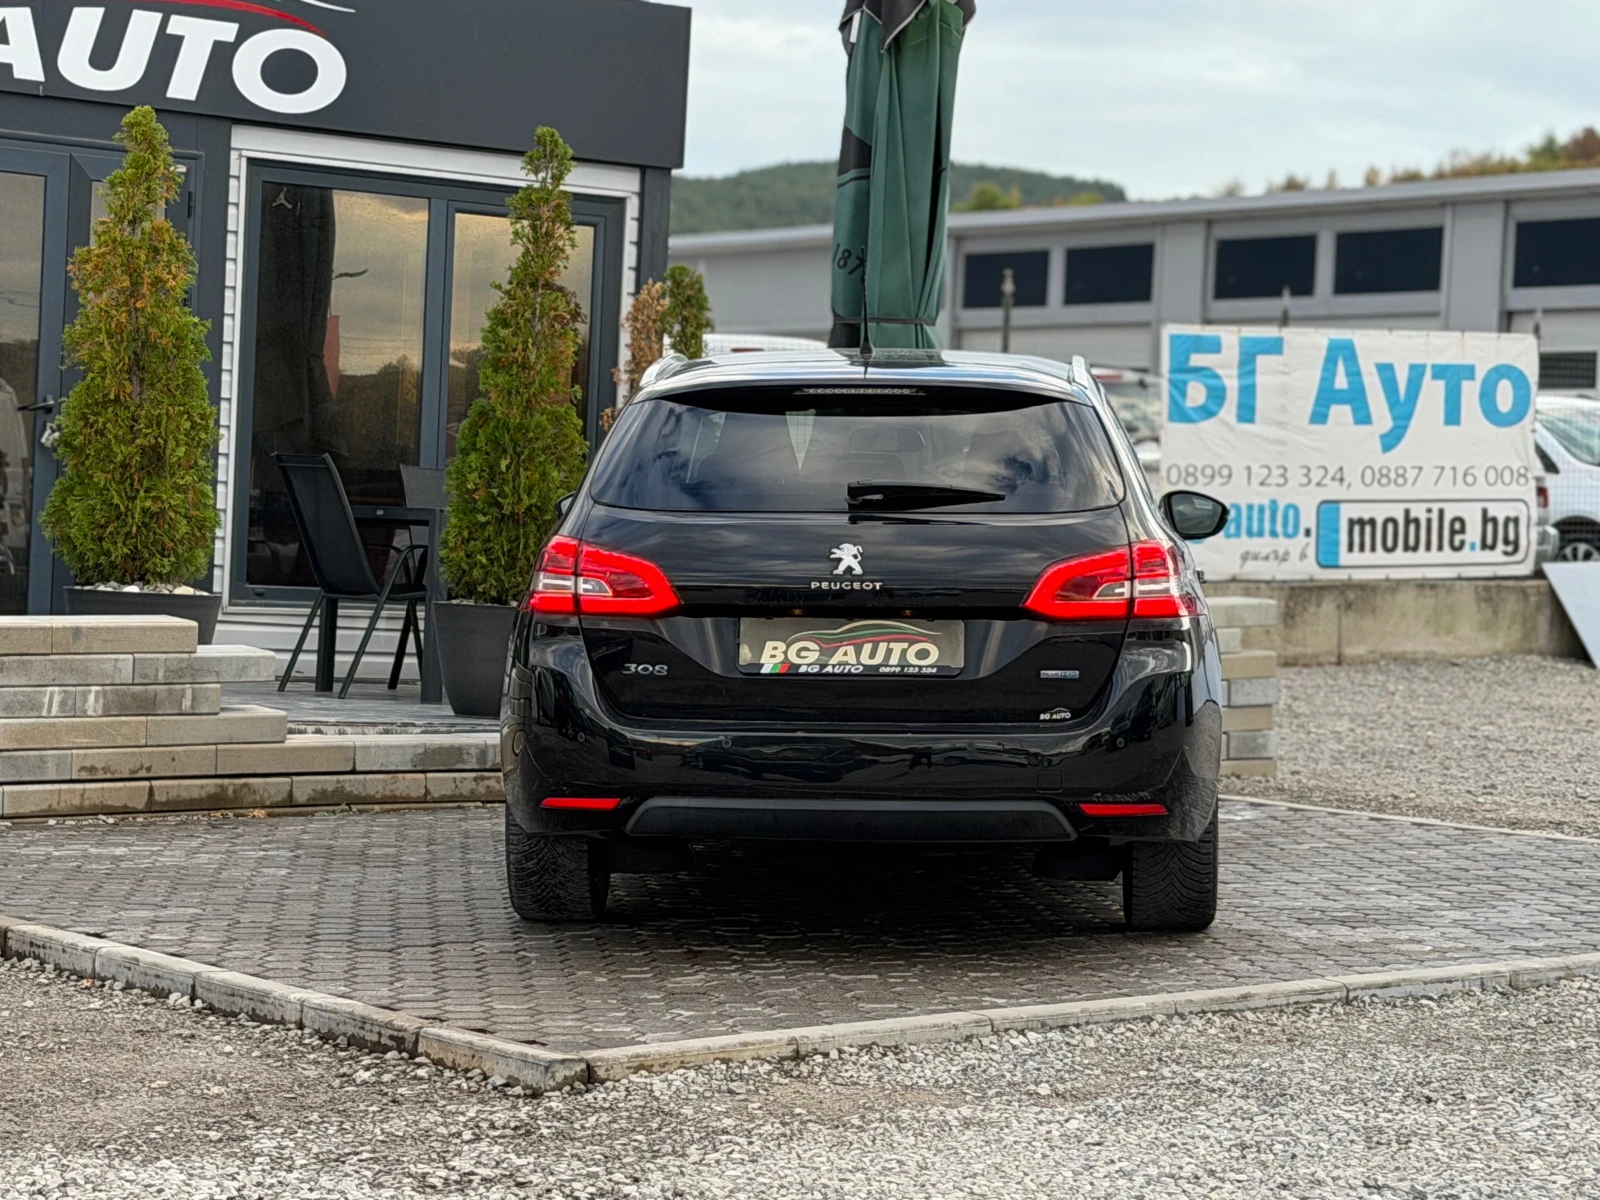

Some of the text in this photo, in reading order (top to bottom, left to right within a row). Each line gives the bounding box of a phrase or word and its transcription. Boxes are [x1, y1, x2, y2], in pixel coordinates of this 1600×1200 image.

[0, 7, 347, 114] AUTO
[1167, 333, 1532, 454] БГ Ауто
[1165, 463, 1529, 491] 0899 123 324, 0887 716 008
[1200, 498, 1520, 557] auto. mobile.bg
[810, 581, 884, 590] PEUGEOT
[760, 640, 940, 666] BG AUTO
[621, 663, 668, 676] 308
[798, 664, 938, 674] BG AUTO 0899 123 324
[1051, 712, 1071, 720] AUTO
